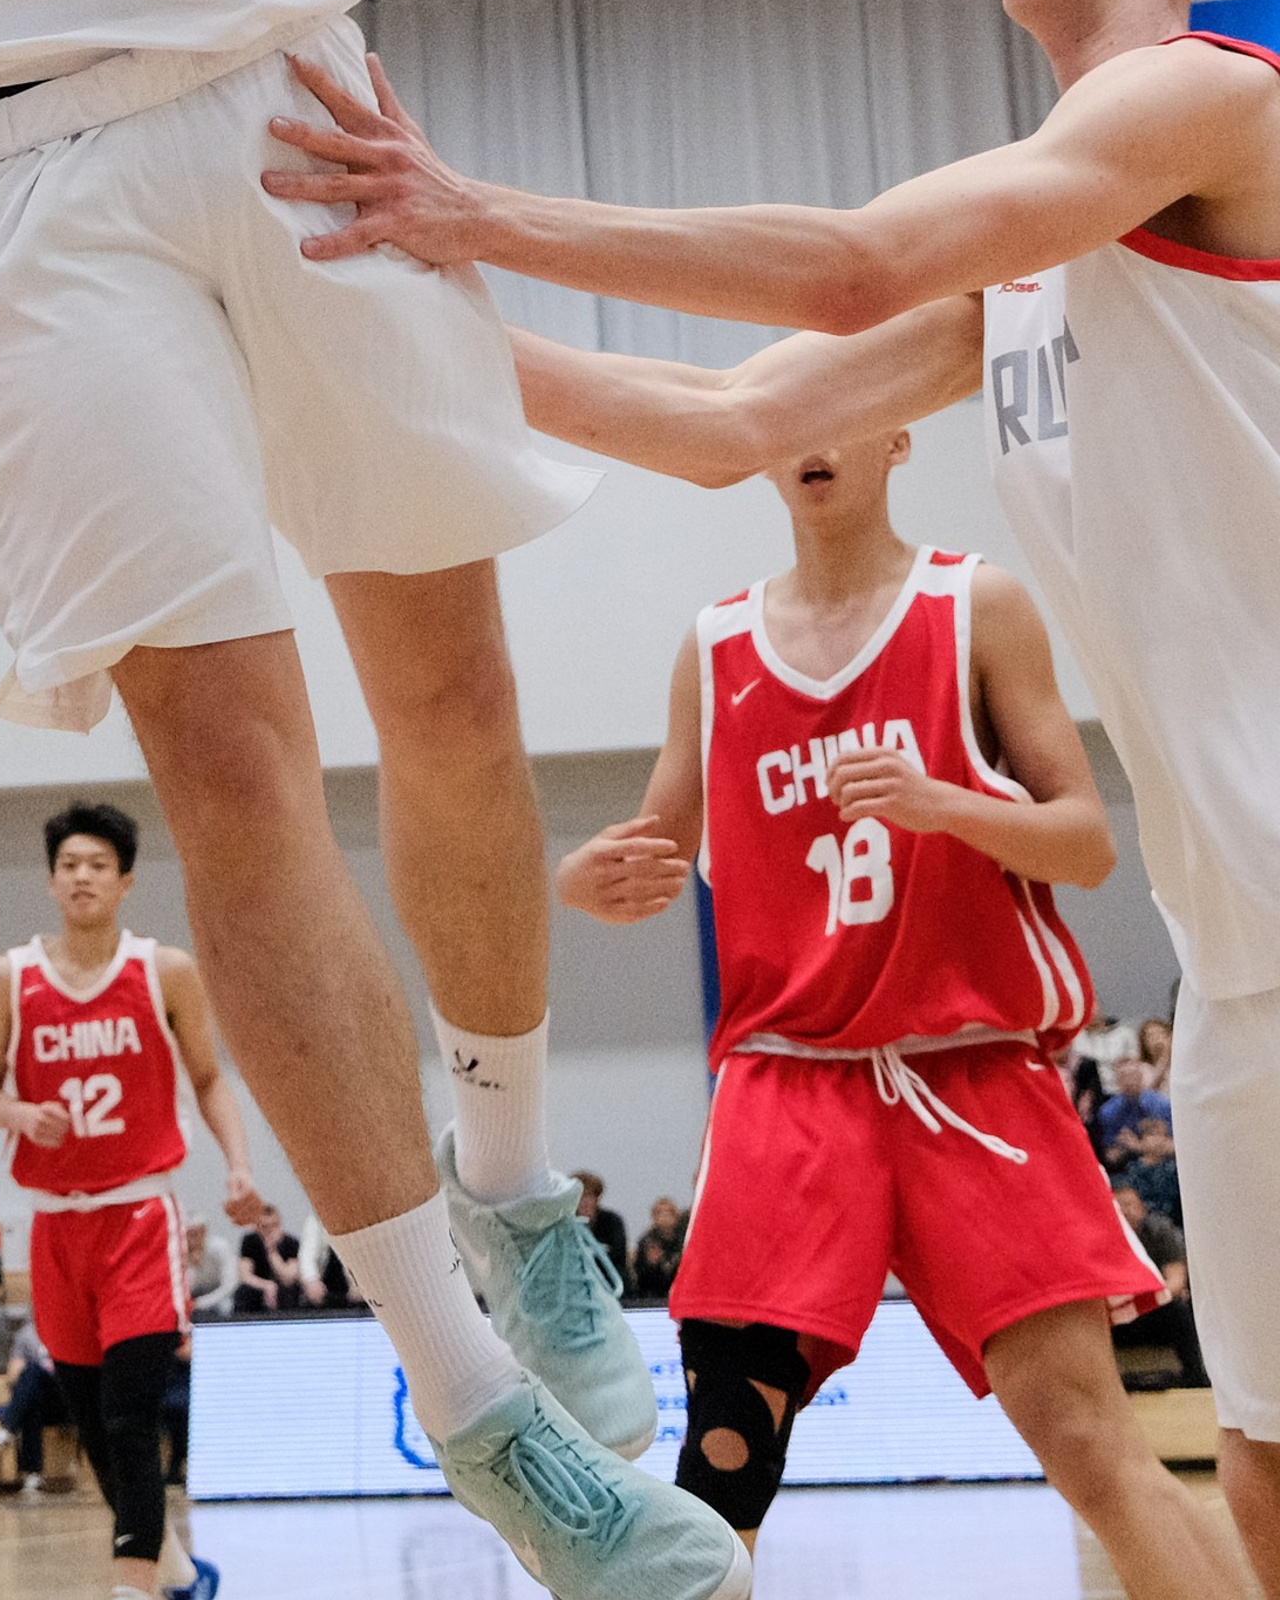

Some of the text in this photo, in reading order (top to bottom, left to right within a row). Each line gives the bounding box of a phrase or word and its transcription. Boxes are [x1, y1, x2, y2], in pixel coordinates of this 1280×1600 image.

[805, 816, 895, 937] 18
[32, 1016, 143, 1064] CHINA
[58, 1073, 126, 1139] 12
